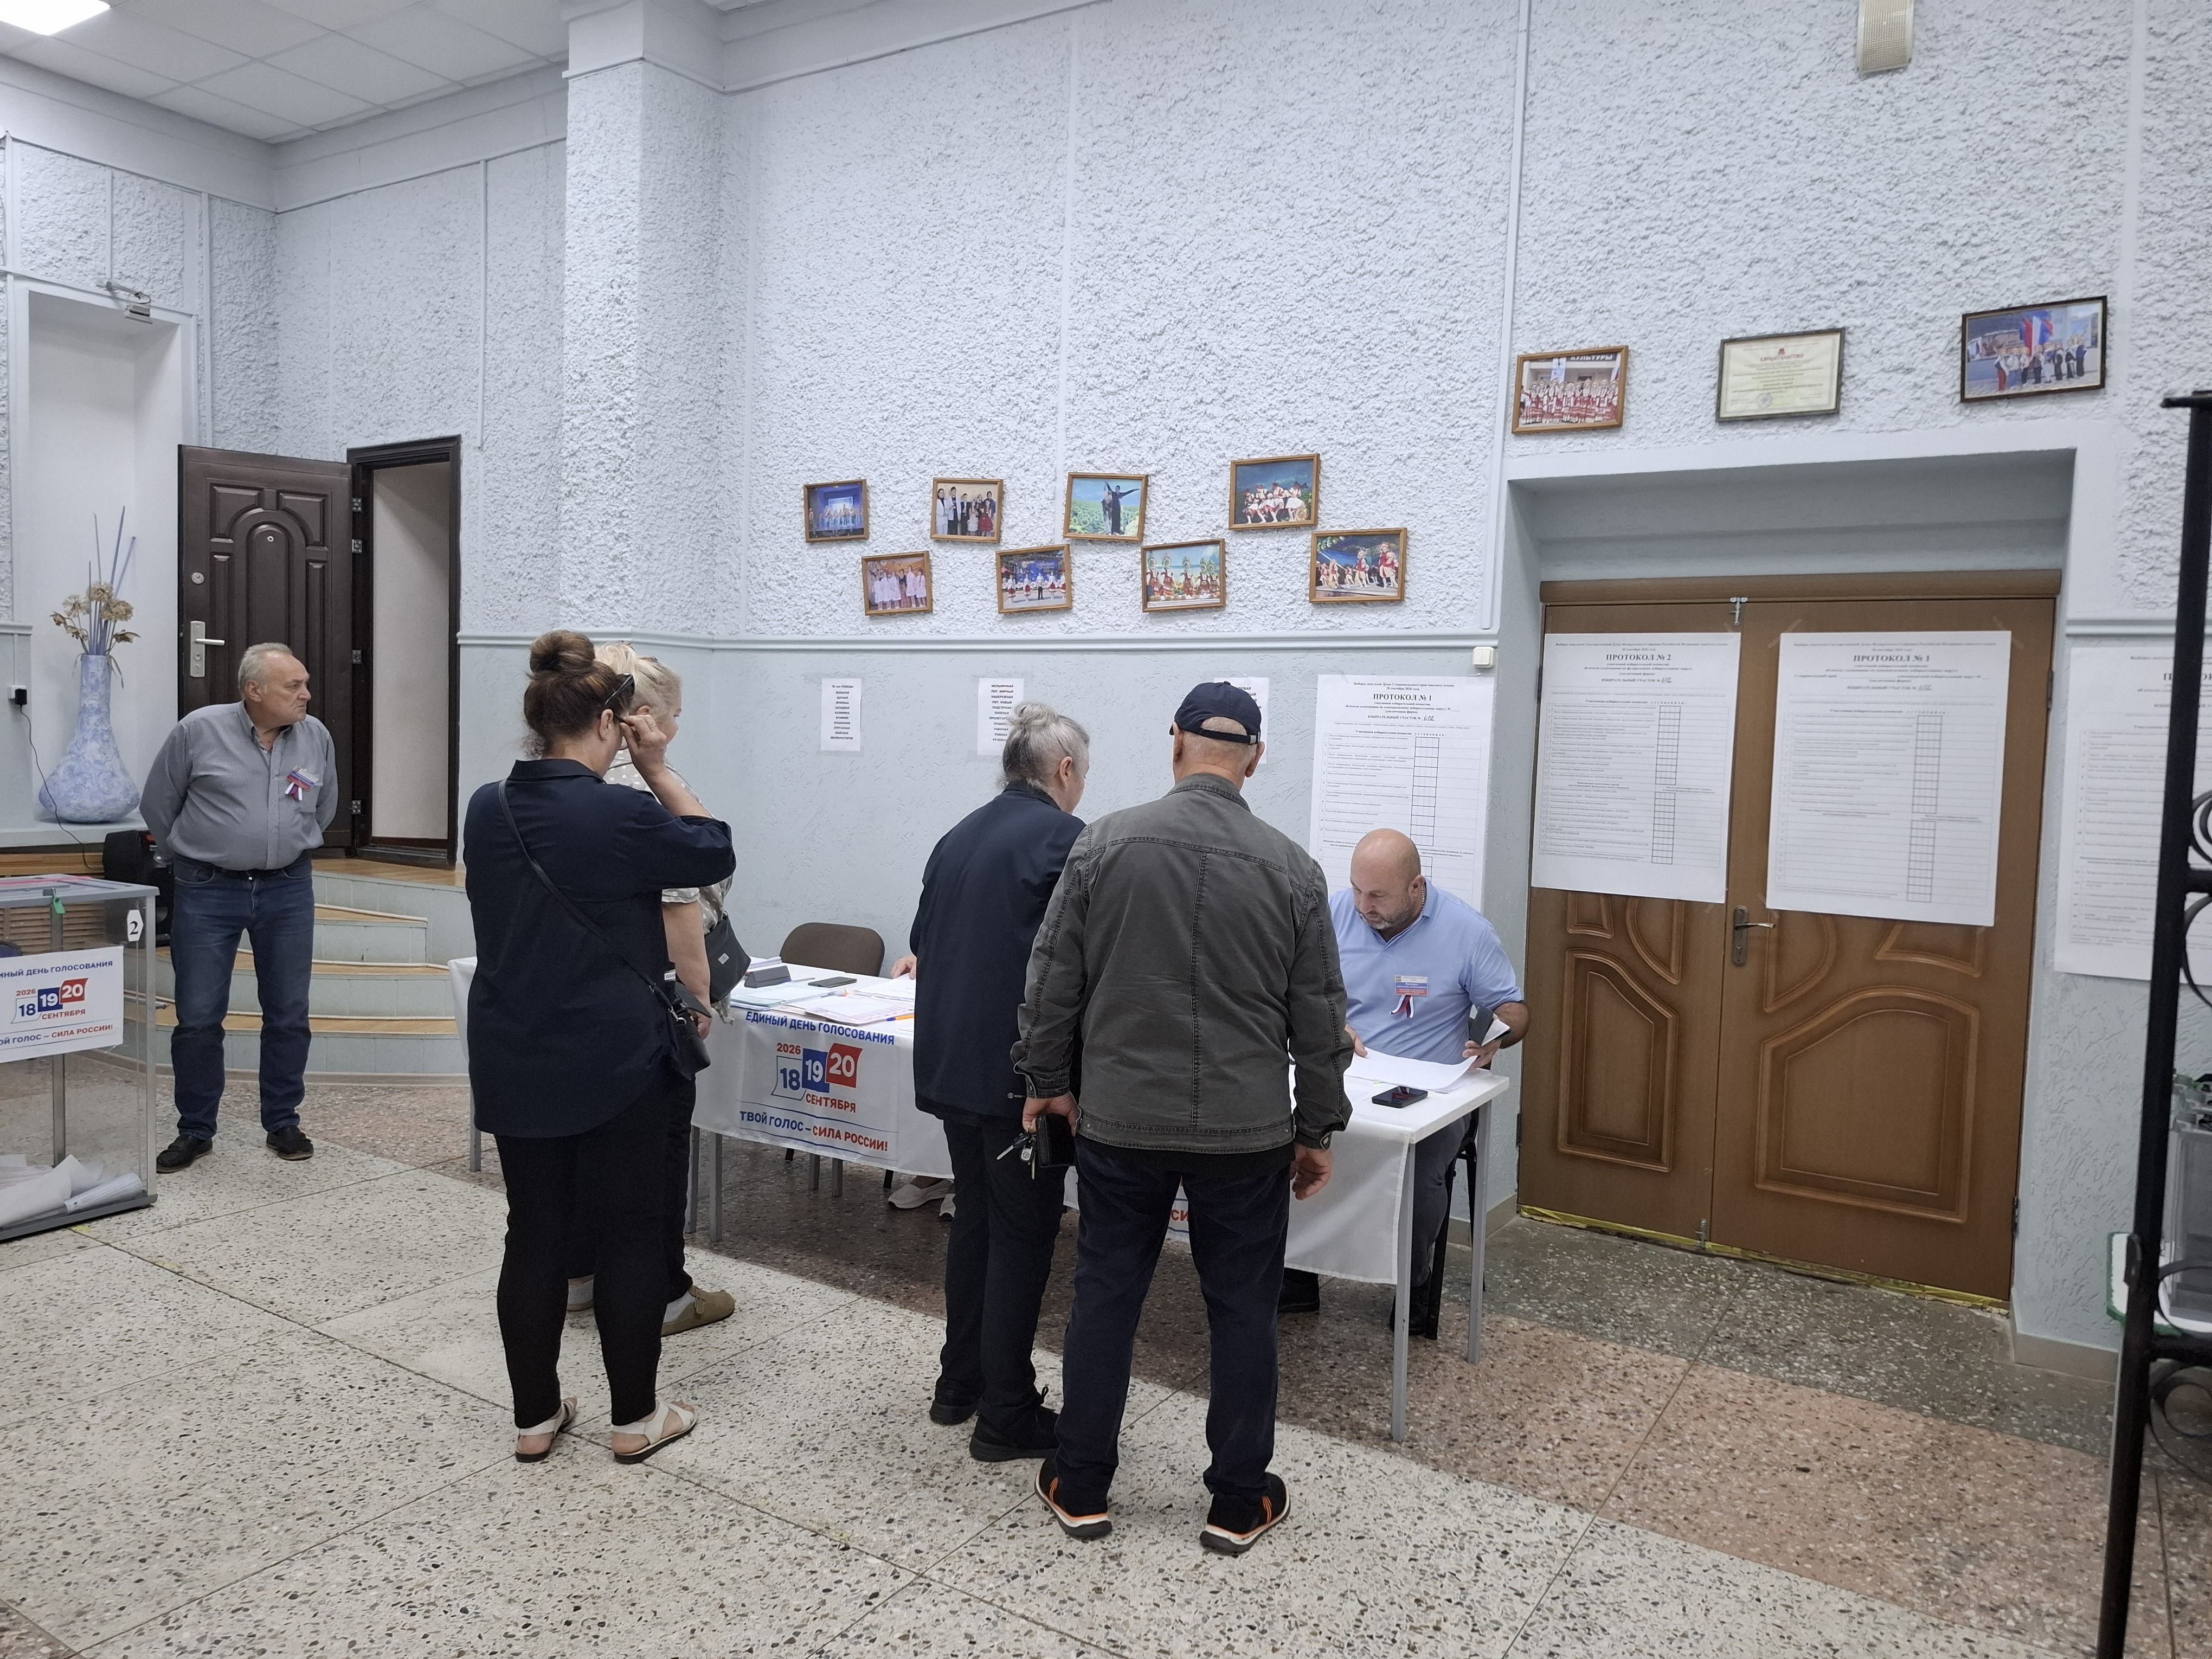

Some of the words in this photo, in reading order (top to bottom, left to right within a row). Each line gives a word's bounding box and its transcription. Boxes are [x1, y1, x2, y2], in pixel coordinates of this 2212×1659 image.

[128, 921, 139, 935] 2
[0, 969, 23, 978] ИНЫЙ
[26, 968, 49, 976] ДЕНЬ
[50, 961, 113, 973] ГОЛОСОВАНИЯ
[18, 1003, 36, 1017] 18
[40, 993, 59, 1007] 19
[62, 983, 83, 999] 20
[42, 1009, 86, 1020] СЕНТЯБРЯ
[0, 1037, 10, 1045] ОЙ
[12, 1034, 41, 1044] ГОЛОС
[52, 1030, 75, 1038] СИЛА
[76, 1024, 113, 1034] РОССИИ!
[745, 1011, 788, 1027] ЕДИНЫЙ
[789, 1019, 816, 1031] ДЕНЬ
[818, 1022, 895, 1045] ГОЛОСОВАНИЯ
[776, 1043, 801, 1054] 2026
[780, 1068, 801, 1091] 18
[805, 1059, 824, 1083] 19
[829, 1052, 855, 1077] 20
[806, 1093, 856, 1113] СЕНТЯБРЯ
[740, 1111, 767, 1124] ТВОЙ
[769, 1116, 803, 1131] ГОЛОС
[813, 1126, 841, 1140] СИЛА
[844, 1131, 888, 1152] РОССИИ!
[1171, 1209, 1189, 1221] СИ
